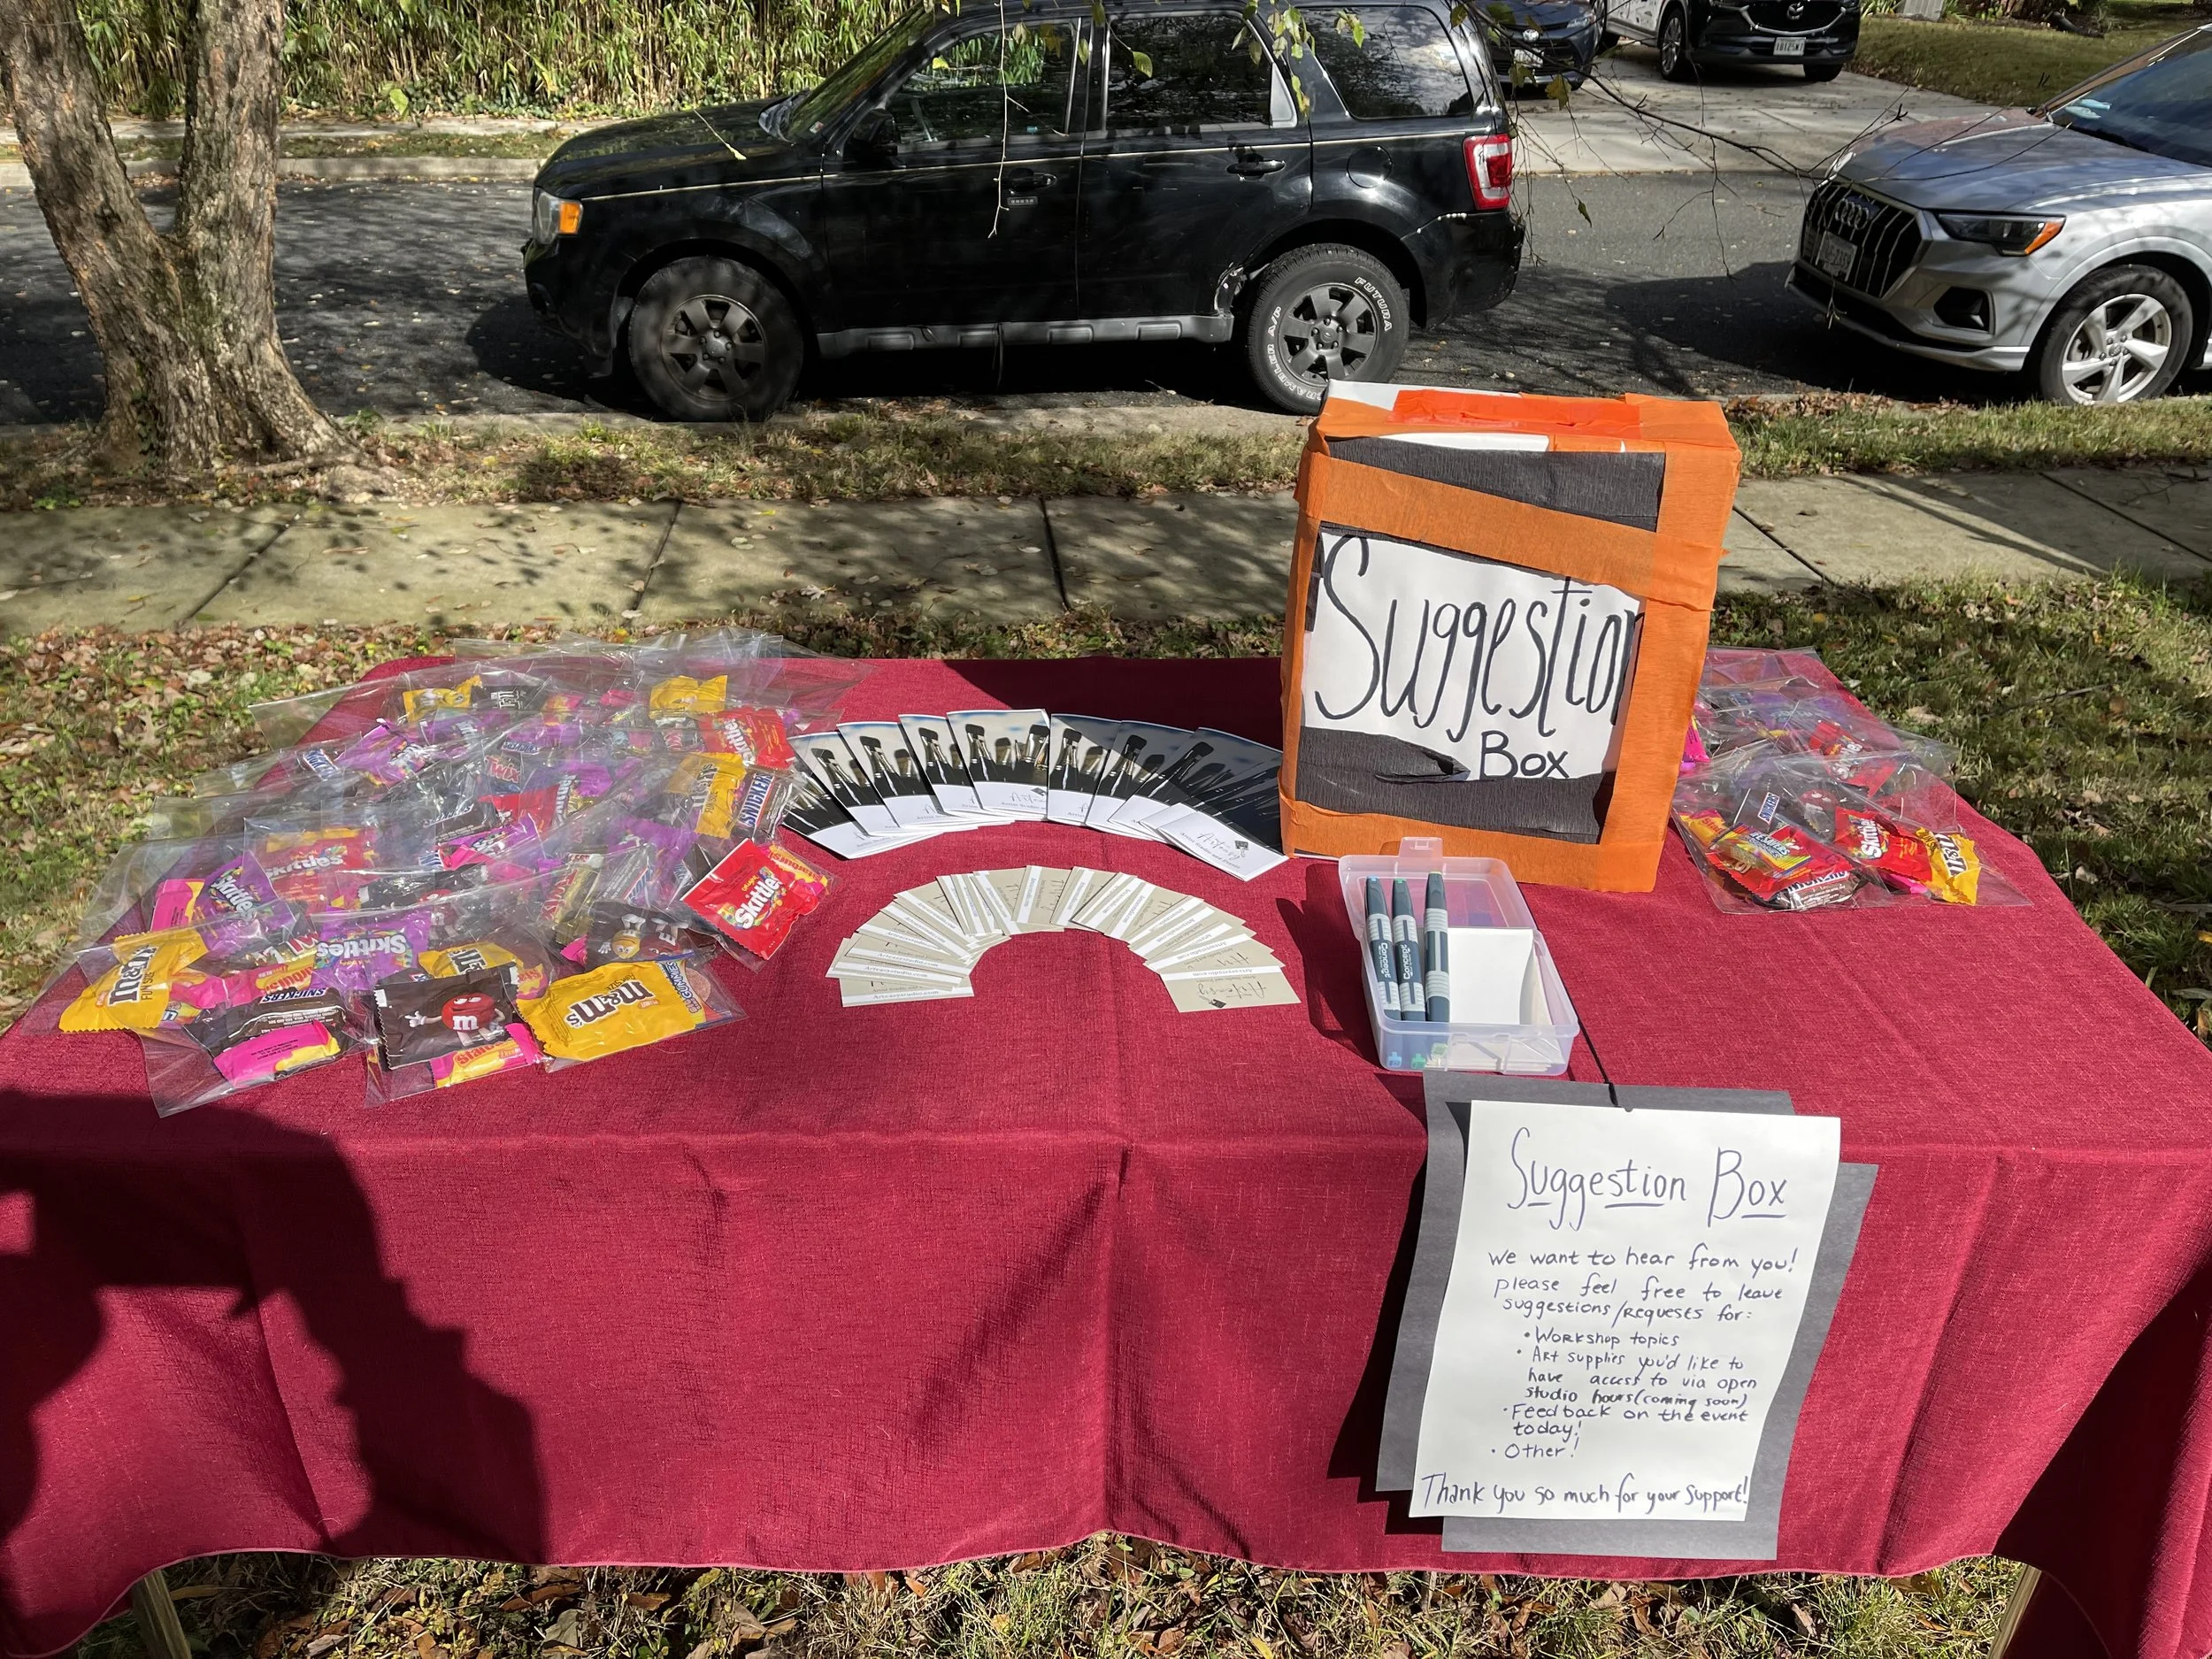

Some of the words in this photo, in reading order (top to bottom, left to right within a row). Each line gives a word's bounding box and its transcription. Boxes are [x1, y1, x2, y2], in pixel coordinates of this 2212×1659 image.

[1354, 276, 1393, 332] FUTURA
[1267, 305, 1282, 337] A/P
[1315, 534, 1644, 743] Suggestion
[1479, 731, 1570, 780] Box
[314, 934, 408, 959] Skittles
[1376, 942, 1392, 978] Concept
[1400, 943, 1413, 980] Concept
[1507, 1127, 1686, 1231] Suggestion
[1707, 1147, 1787, 1227] Box
[1489, 1250, 1517, 1266] we
[1531, 1251, 1578, 1266] want
[1588, 1251, 1616, 1267] to
[1625, 1247, 1675, 1266] hear
[1688, 1242, 1740, 1271] from
[1750, 1248, 1798, 1278] you!
[1580, 1272, 1617, 1296] feel
[1642, 1277, 1686, 1300] free
[1703, 1283, 1723, 1300] to
[1738, 1284, 1783, 1301] leave
[1717, 1302, 1752, 1322] for:
[1630, 1332, 1680, 1348] topics
[1527, 1368, 1563, 1384] have
[1650, 1371, 1668, 1386] to
[1683, 1378, 1706, 1389] via
[1717, 1379, 1757, 1392] open
[1568, 1352, 1625, 1370] supplies
[1638, 1352, 1681, 1379] you'd
[1687, 1356, 1724, 1371] like
[1729, 1357, 1744, 1370] to
[1525, 1386, 1578, 1403] studio
[1704, 1392, 1747, 1409] soon)
[1511, 1404, 1612, 1419] Feedback
[1624, 1408, 1648, 1419] on
[1657, 1408, 1694, 1422] the
[1701, 1409, 1748, 1422] event
[1513, 1420, 1582, 1441] today!
[1504, 1437, 1578, 1459] Other!
[1420, 1471, 1485, 1509] Thank
[1494, 1484, 1525, 1513] you
[1535, 1484, 1555, 1506] so
[1564, 1485, 1609, 1504] much
[1615, 1472, 1637, 1512] for
[1647, 1486, 1680, 1514] your
